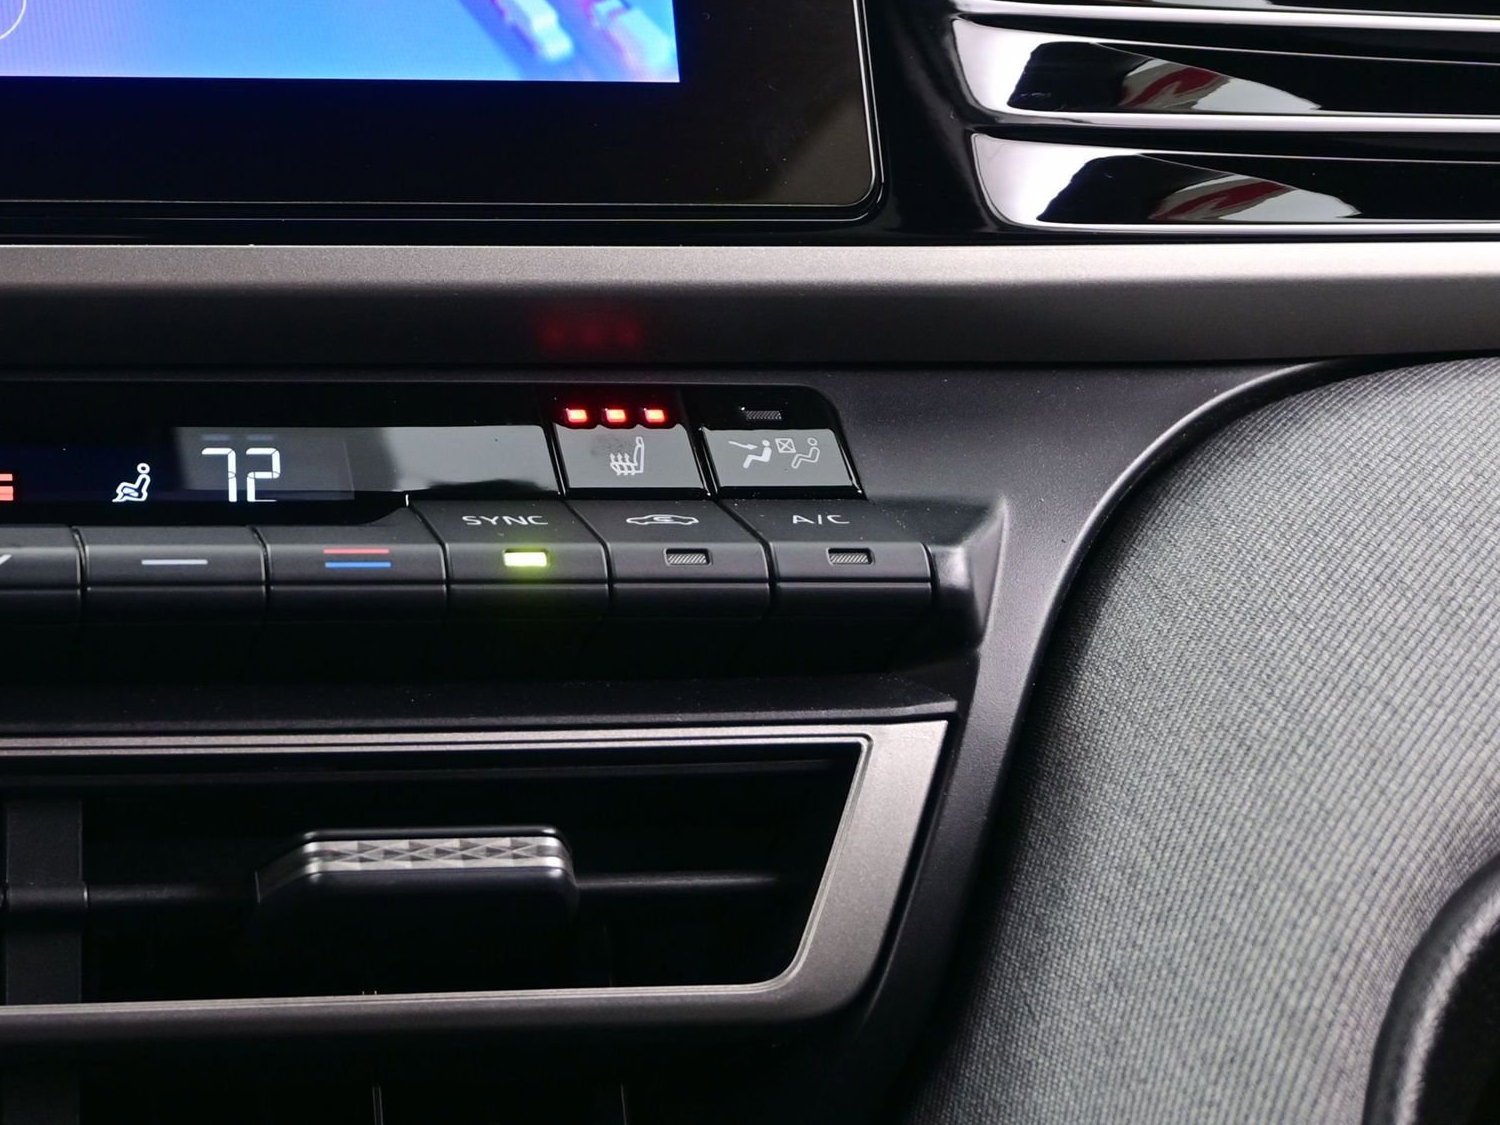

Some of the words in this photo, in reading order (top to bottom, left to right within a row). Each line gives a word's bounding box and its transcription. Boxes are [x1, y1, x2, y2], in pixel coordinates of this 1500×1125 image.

[200, 447, 282, 503] 72
[461, 515, 549, 526] SYNC
[792, 514, 850, 525] A/C
